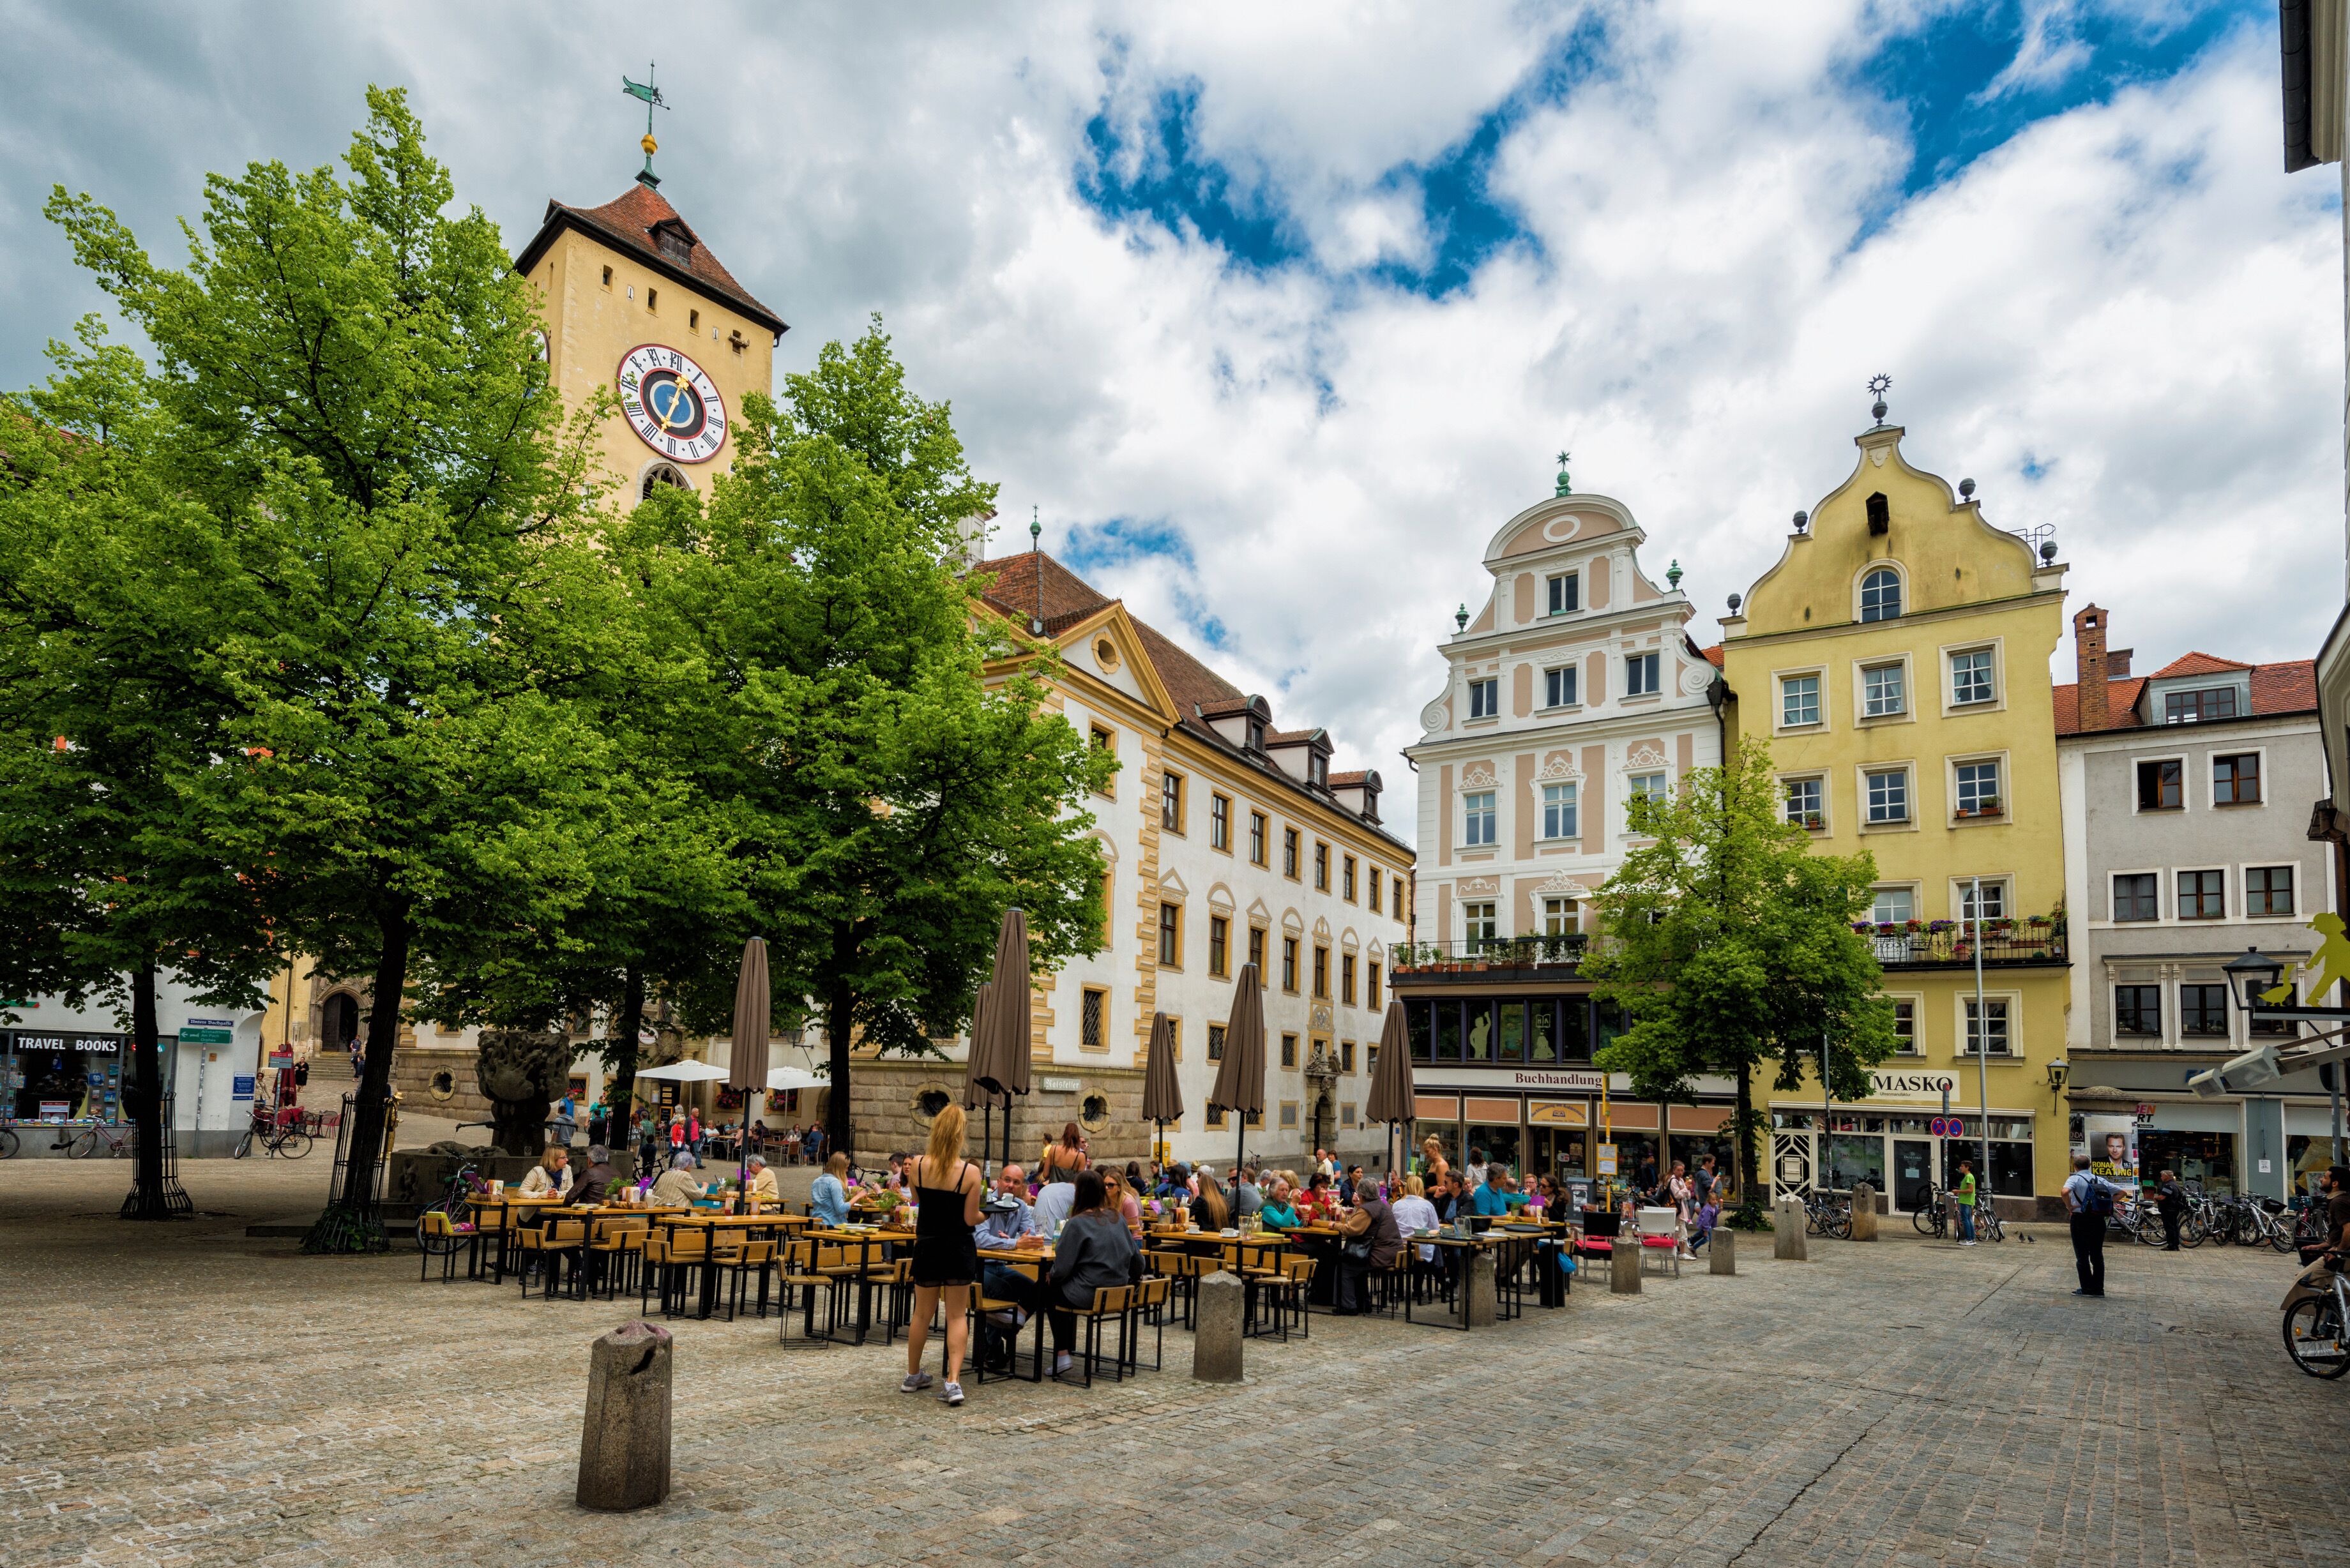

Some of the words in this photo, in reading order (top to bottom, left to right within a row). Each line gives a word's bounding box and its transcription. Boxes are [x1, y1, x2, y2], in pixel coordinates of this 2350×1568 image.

[18, 1037, 66, 1050] TRAVEL
[75, 1039, 117, 1052] BOOKS
[1046, 1079, 1079, 1089] Ratskeller
[1515, 1073, 1602, 1089] Buchhandlung
[1874, 1076, 1953, 1092] MASKO
[2092, 1168, 2132, 1176] KEATING
